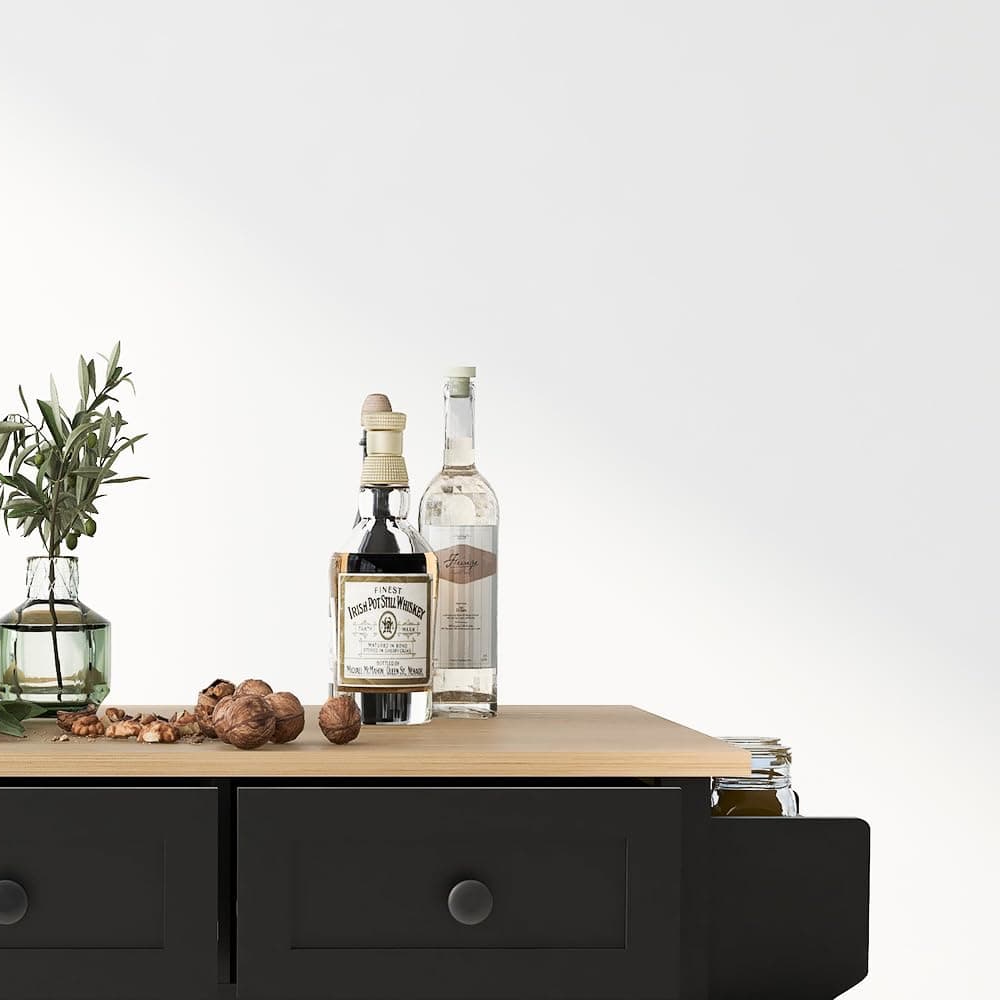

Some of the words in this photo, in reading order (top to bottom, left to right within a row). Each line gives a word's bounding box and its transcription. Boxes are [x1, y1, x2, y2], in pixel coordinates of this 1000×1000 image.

[374, 586, 402, 594] FINEST
[348, 601, 368, 620] IRISH
[368, 597, 380, 611] POT
[380, 594, 396, 608] STILL
[396, 595, 426, 620] WHISKEY
